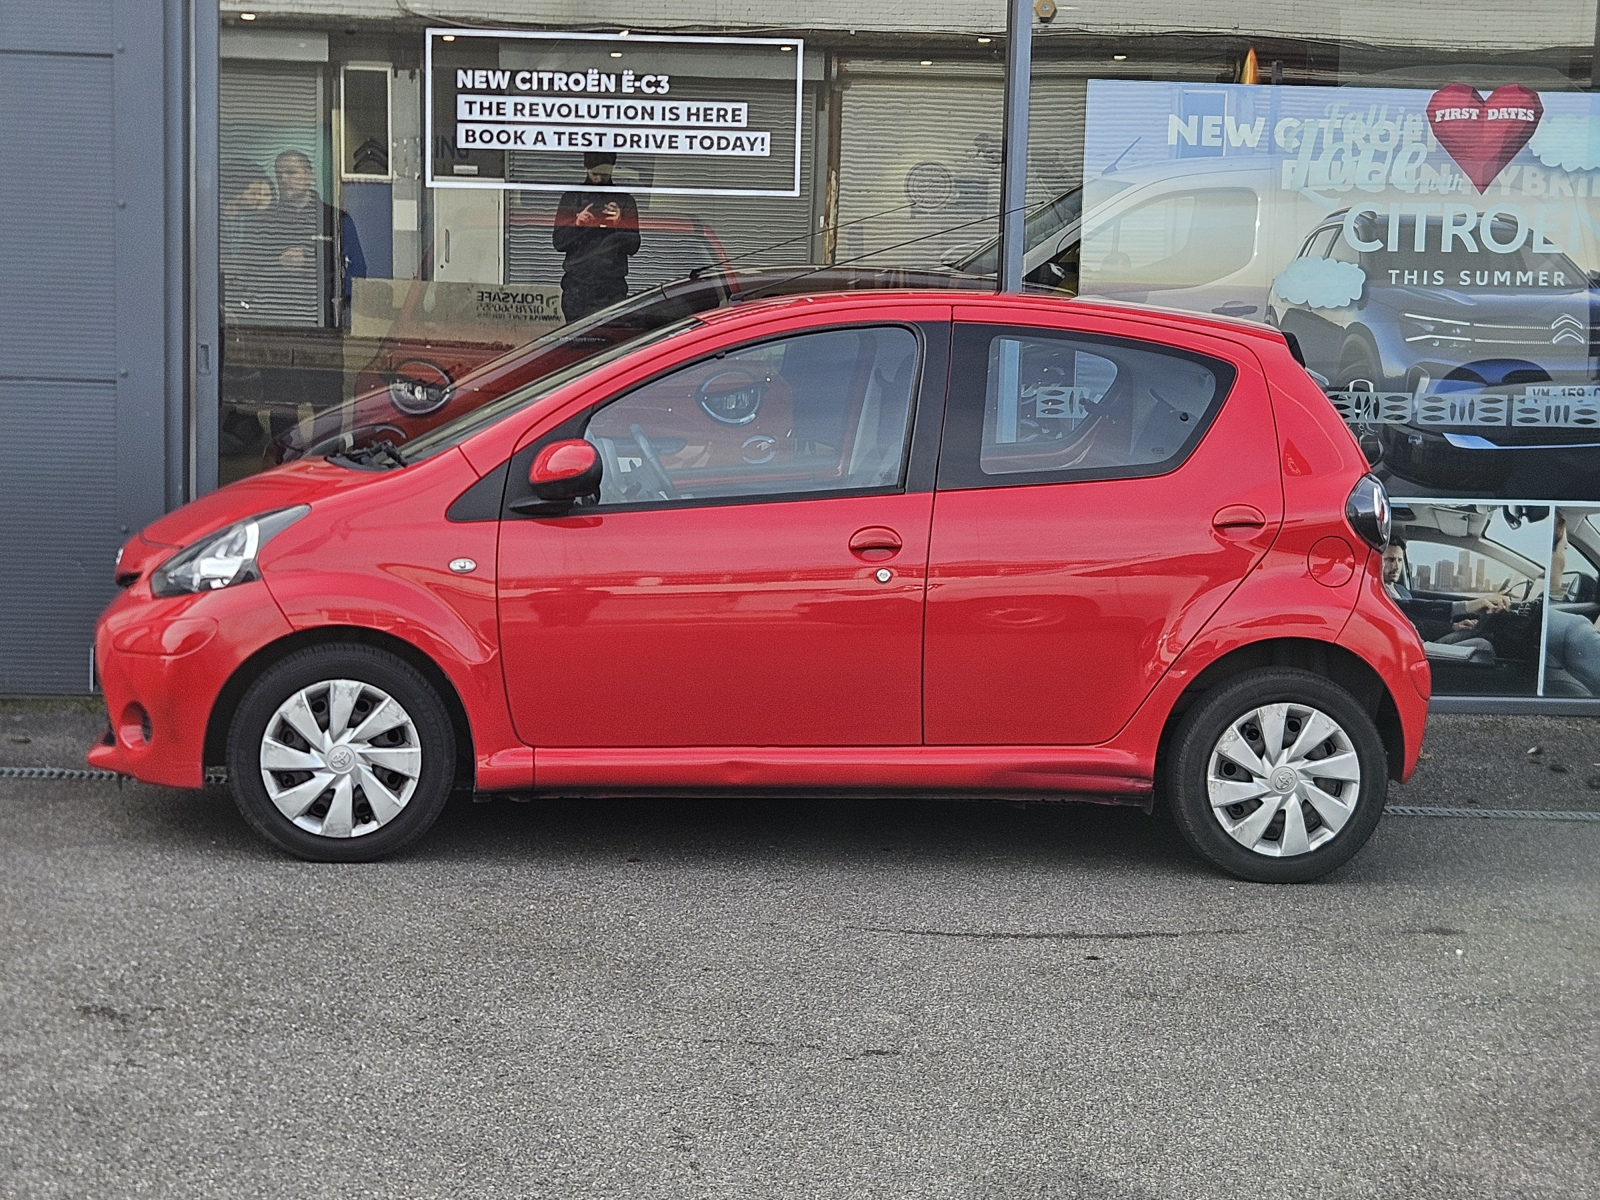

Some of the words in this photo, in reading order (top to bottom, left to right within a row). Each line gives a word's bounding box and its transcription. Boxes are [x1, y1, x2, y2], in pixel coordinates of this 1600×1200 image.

[456, 69, 511, 90] NEW
[514, 68, 616, 93] CITROËN
[621, 70, 670, 94] Ë-C3
[464, 100, 507, 117] THE
[513, 102, 655, 122] REVOLUTION
[661, 105, 681, 122] IS
[686, 106, 743, 124] HERE
[1435, 107, 1480, 122] FIRST
[1487, 107, 1535, 122] DATES
[464, 129, 526, 146] BOOK
[533, 132, 547, 146] A
[553, 131, 608, 148] TEST
[613, 133, 679, 150] DRIVE
[685, 135, 766, 153] TODAY!
[1167, 113, 1266, 148] NEW
[1388, 269, 1446, 285] THIS
[1459, 270, 1566, 286] SUMMER
